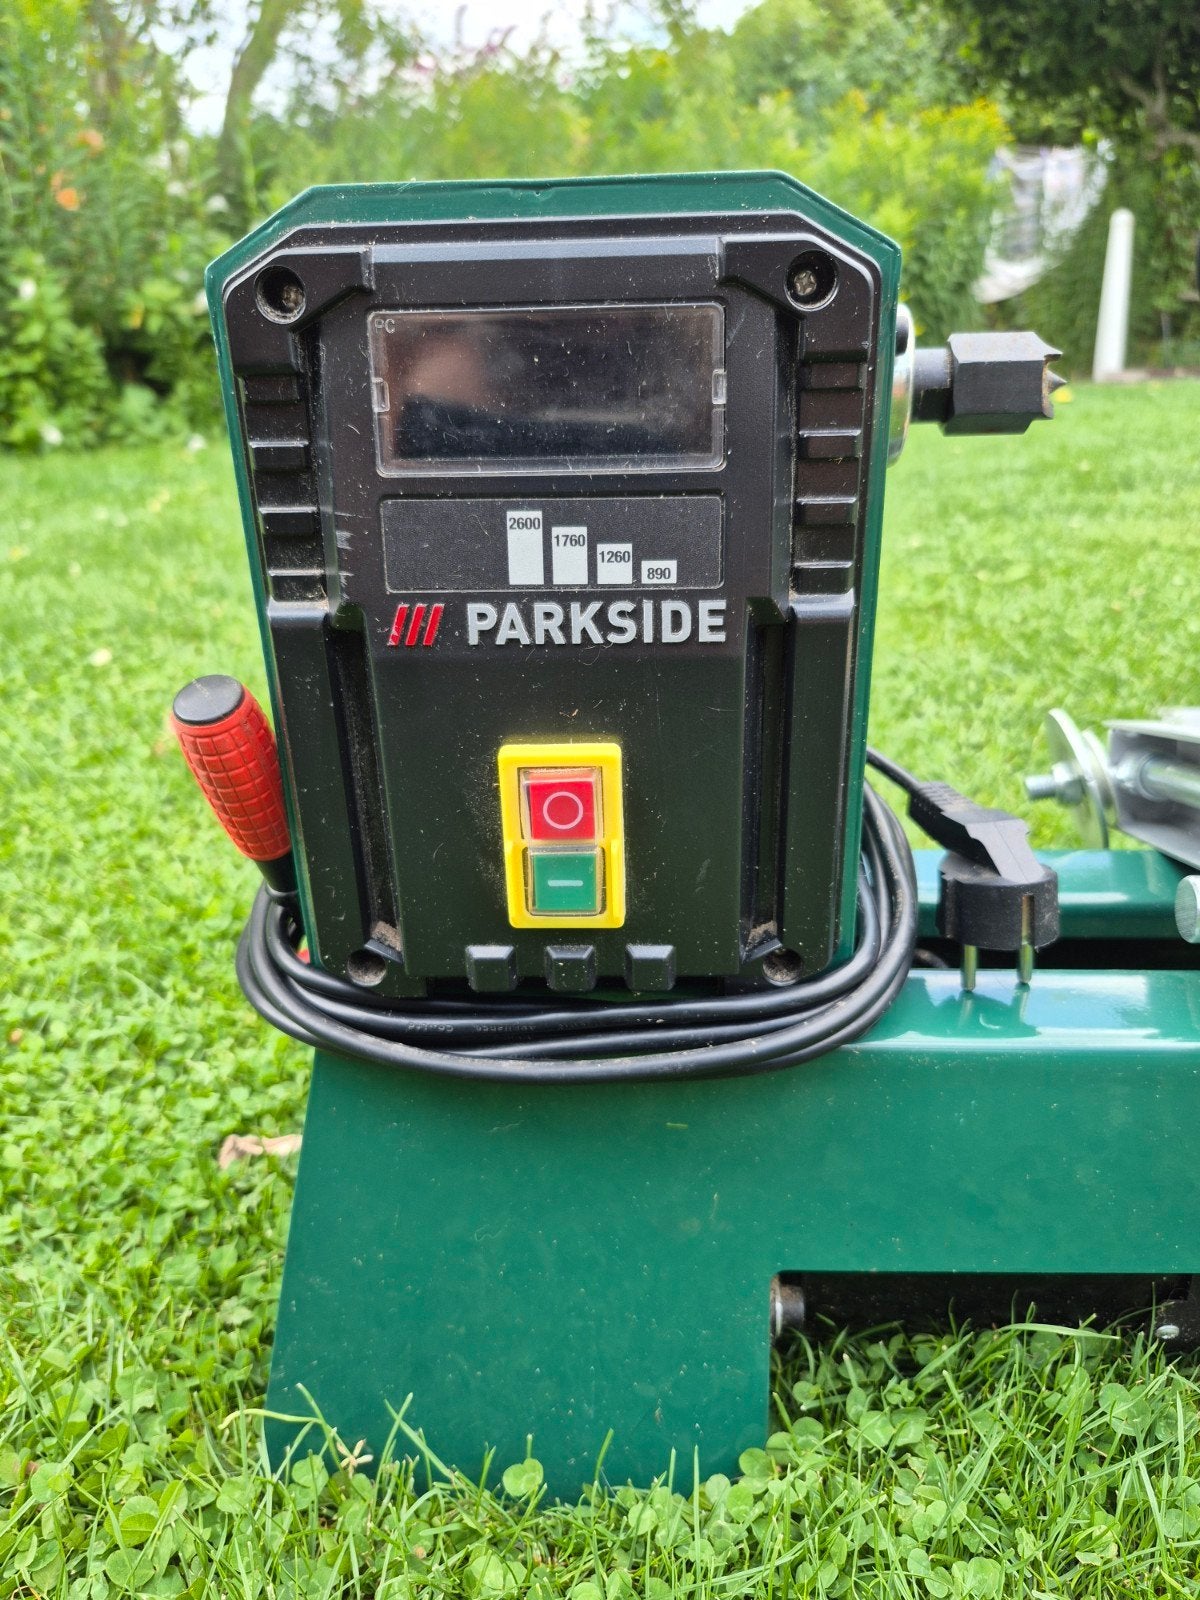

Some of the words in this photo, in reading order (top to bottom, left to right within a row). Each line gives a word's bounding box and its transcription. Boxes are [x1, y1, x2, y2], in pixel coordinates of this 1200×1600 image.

[508, 517, 541, 531] 2600
[554, 534, 586, 548] 1760
[599, 550, 631, 564] 1260
[646, 567, 671, 580] 890
[466, 599, 727, 646] PARKSIDE
